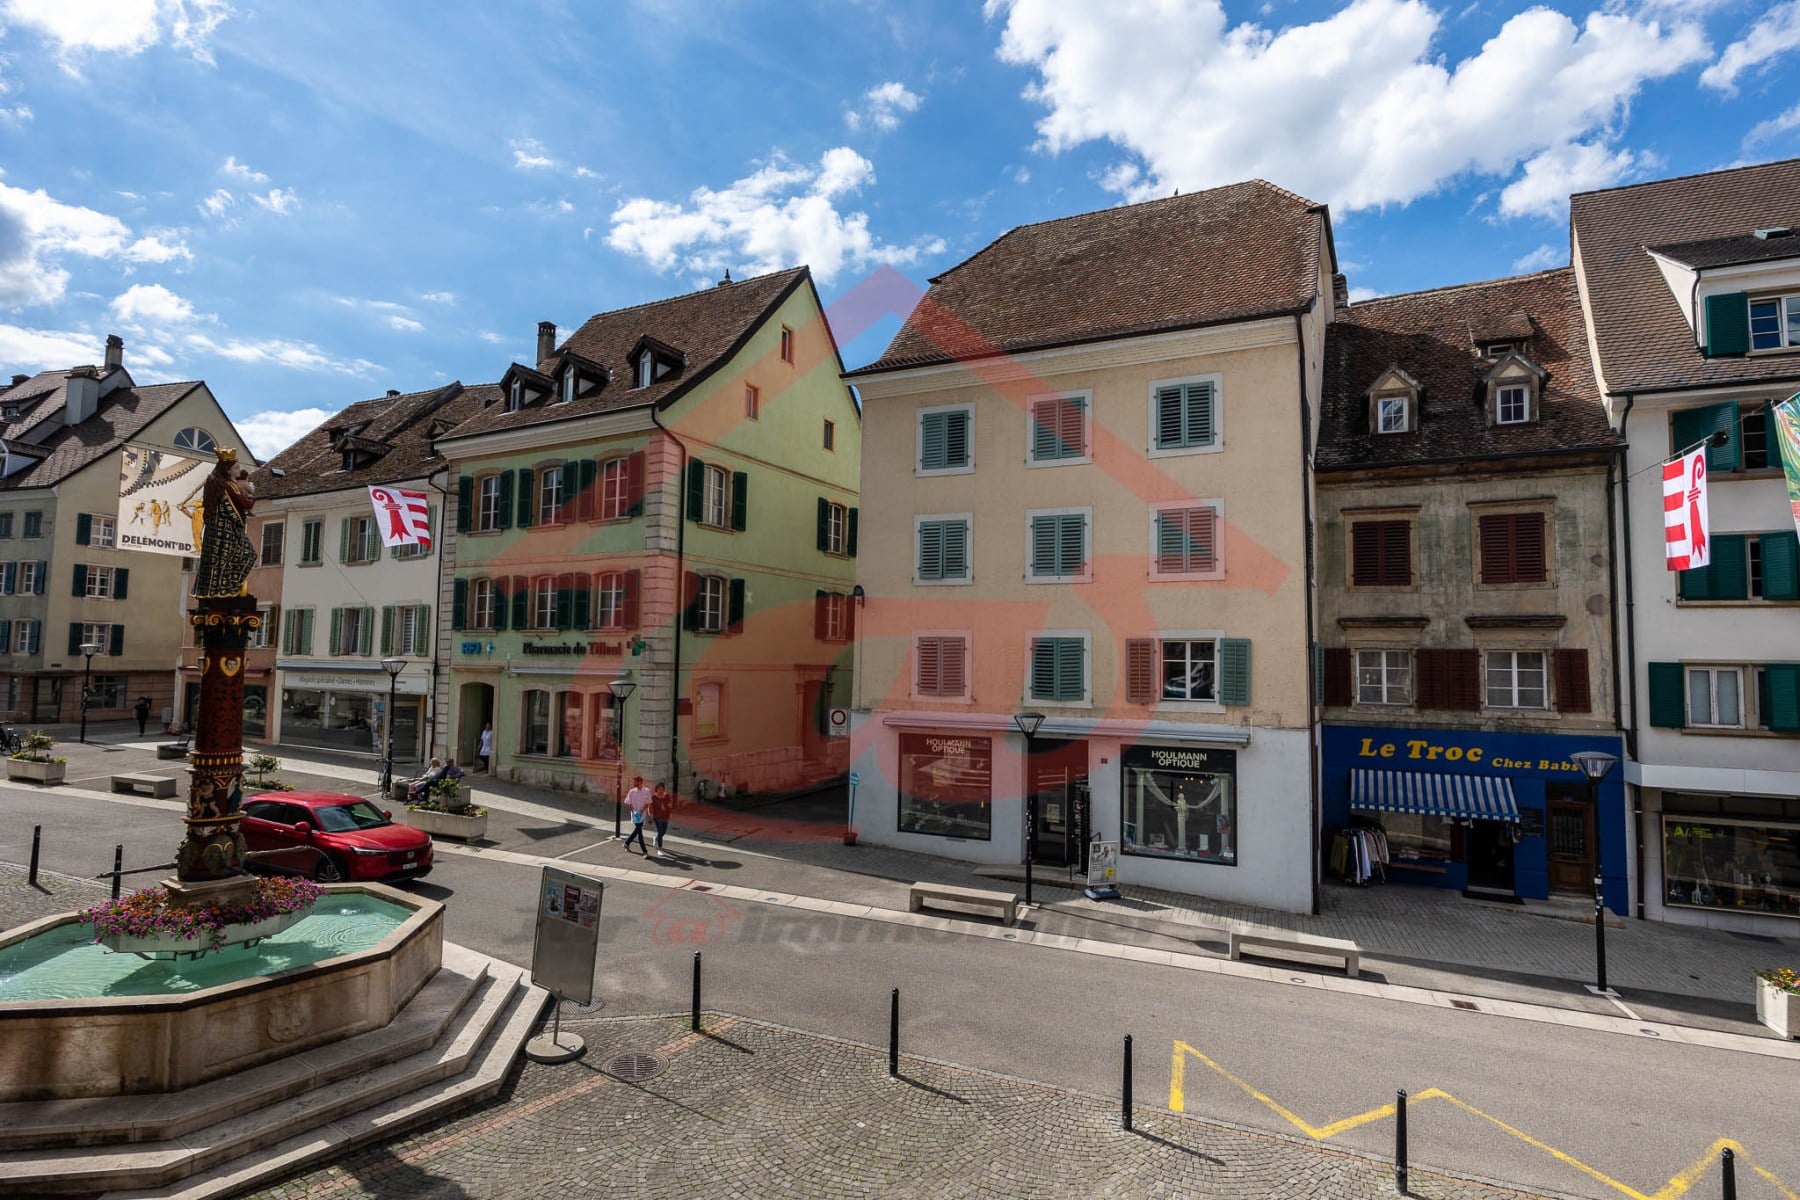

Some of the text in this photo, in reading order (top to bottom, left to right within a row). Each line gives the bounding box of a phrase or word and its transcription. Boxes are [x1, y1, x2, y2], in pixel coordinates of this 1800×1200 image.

[122, 534, 192, 551] DELÉMONT'BD
[523, 642, 571, 655] Pharmacie
[573, 642, 586, 655] du
[926, 738, 971, 749] HOULMANN
[931, 745, 966, 754] OPTIQUE
[1151, 750, 1208, 762] HOULMANN
[1359, 738, 1579, 772] Le Troc Chez Babs
[1158, 758, 1201, 769] OPTIQUE
